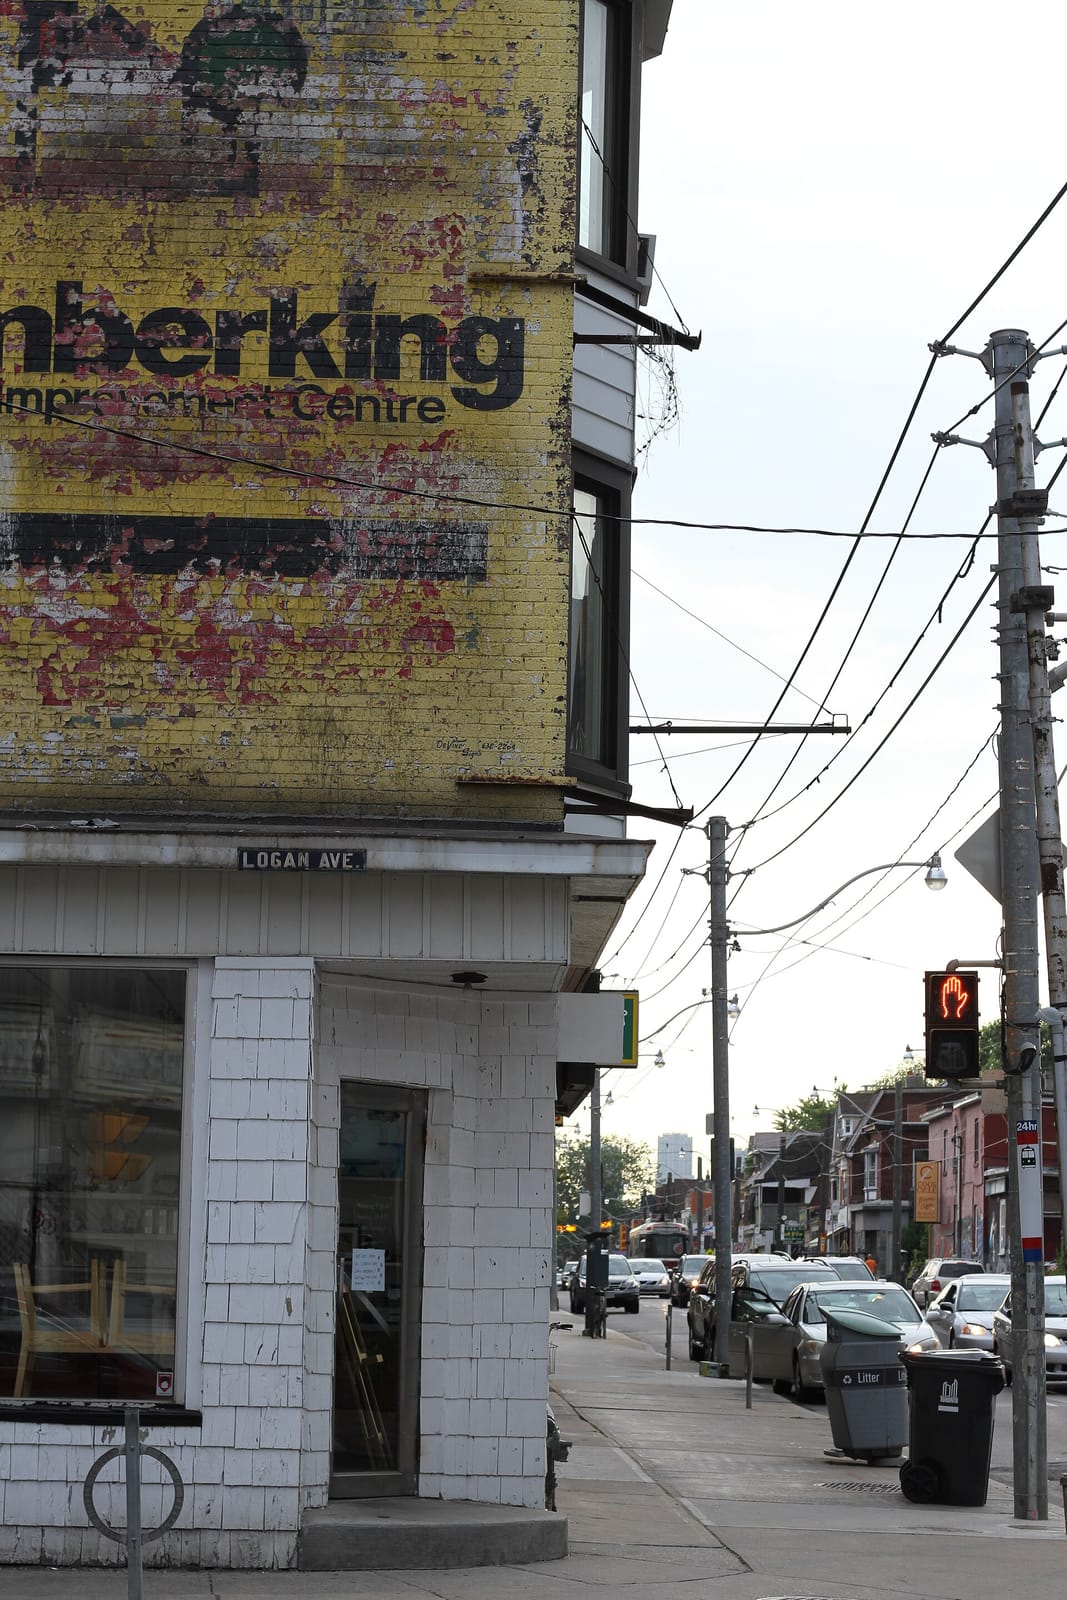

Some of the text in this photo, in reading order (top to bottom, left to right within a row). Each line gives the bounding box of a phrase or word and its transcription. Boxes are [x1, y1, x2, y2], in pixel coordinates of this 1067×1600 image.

[294, 384, 447, 424] Centre
[242, 851, 360, 869] LOGAN AVE.
[1016, 1121, 1037, 1132] 24hr
[857, 1372, 880, 1384] Litter
